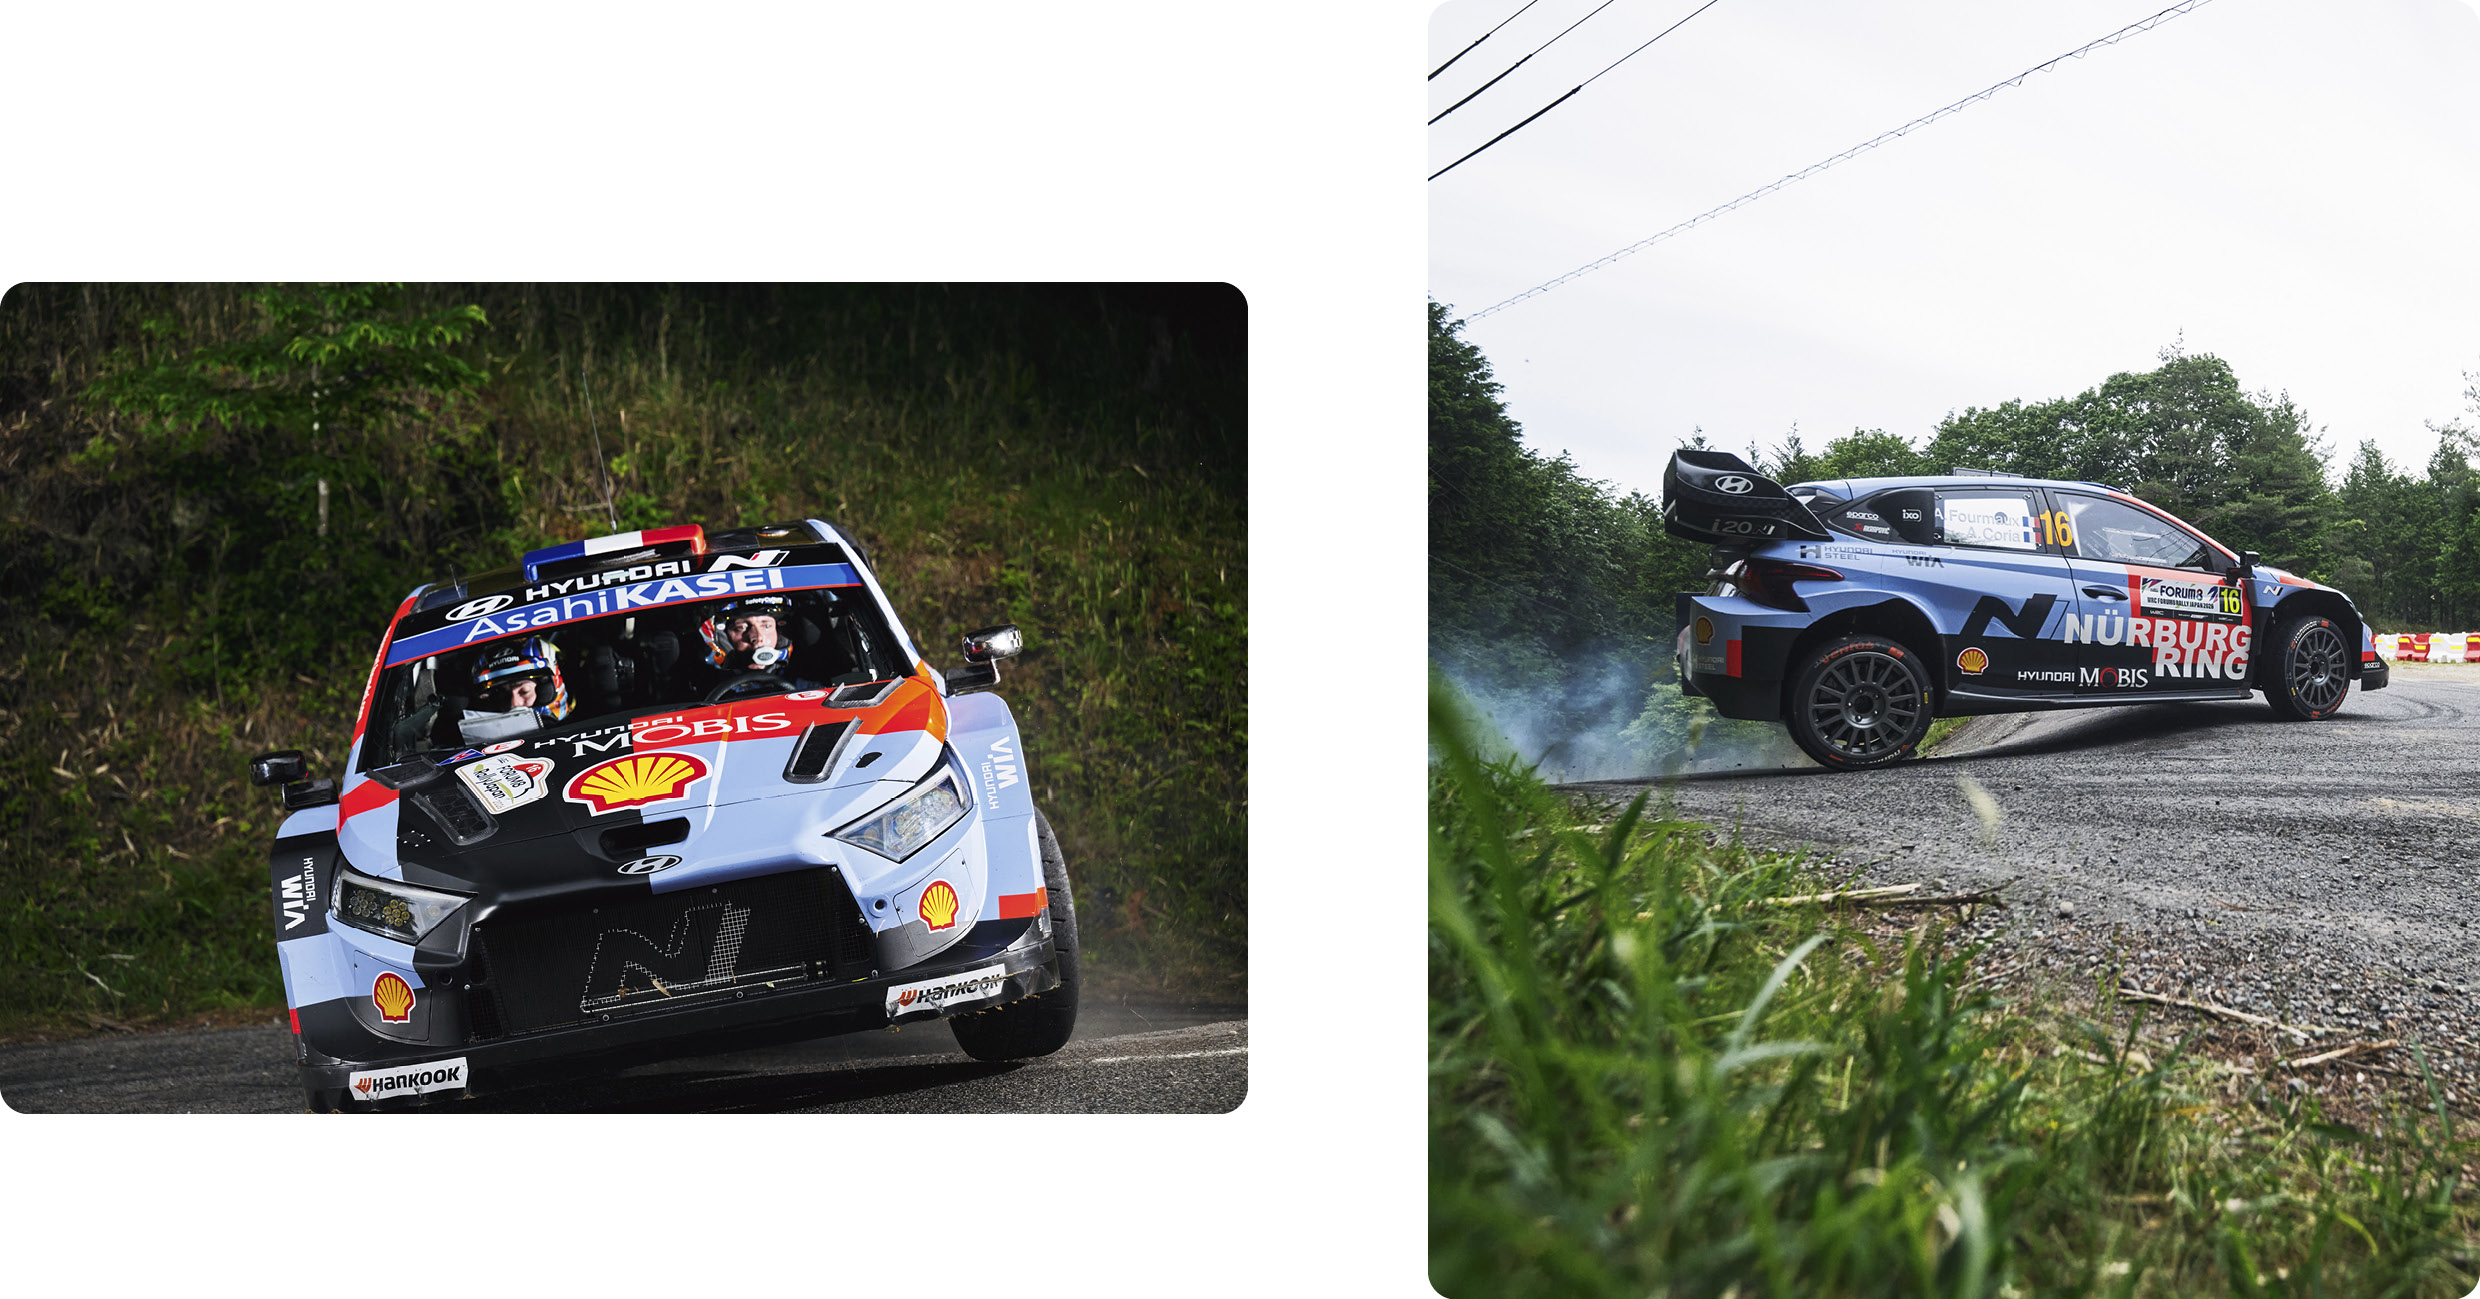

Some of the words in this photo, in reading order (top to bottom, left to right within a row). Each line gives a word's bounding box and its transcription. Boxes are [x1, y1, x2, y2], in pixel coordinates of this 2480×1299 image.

[2039, 509, 2073, 547] 16
[1824, 546, 1873, 555] HYUNDAI
[1824, 552, 1860, 561] STEEL
[526, 560, 690, 601] HYUNDAI
[2160, 585, 2203, 601] FORUM8
[2221, 588, 2240, 614] 16
[2064, 609, 2252, 652] NÜRBURG
[2018, 671, 2075, 681] HYUNDAI
[2079, 667, 2148, 688] MOBIS
[2155, 648, 2249, 680] RING
[534, 716, 683, 749] HYUNDAI
[573, 712, 791, 757] MOBIS
[981, 762, 999, 810] HYUNDAI
[303, 857, 316, 901] HYUNDAI
